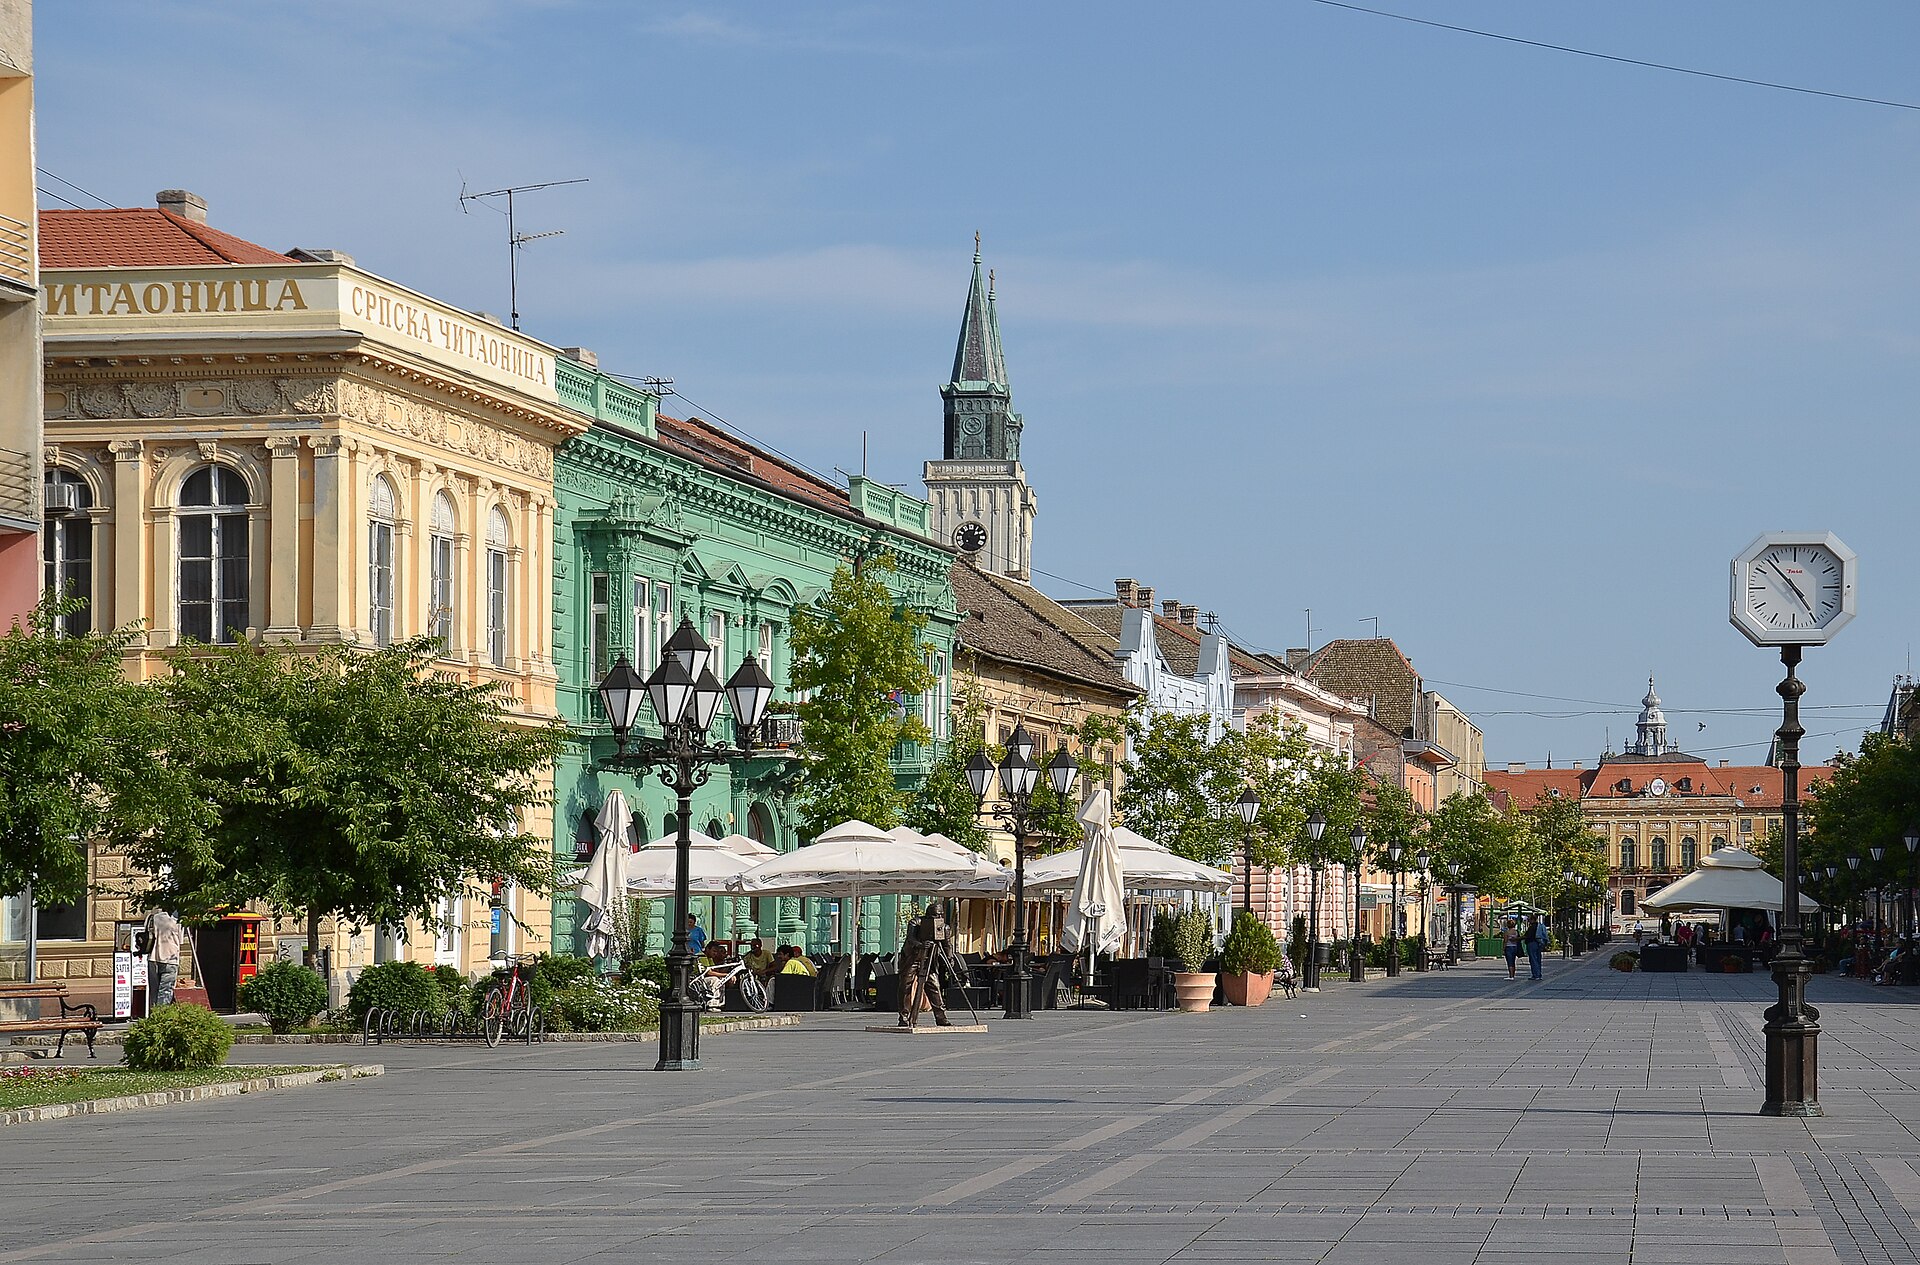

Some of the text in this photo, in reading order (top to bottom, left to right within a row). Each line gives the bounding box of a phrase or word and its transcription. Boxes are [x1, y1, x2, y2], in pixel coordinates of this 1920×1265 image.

[44, 279, 309, 315] ИТАОНИЦА
[351, 286, 547, 386] СРПСКА ЧИТАОНИЦА
